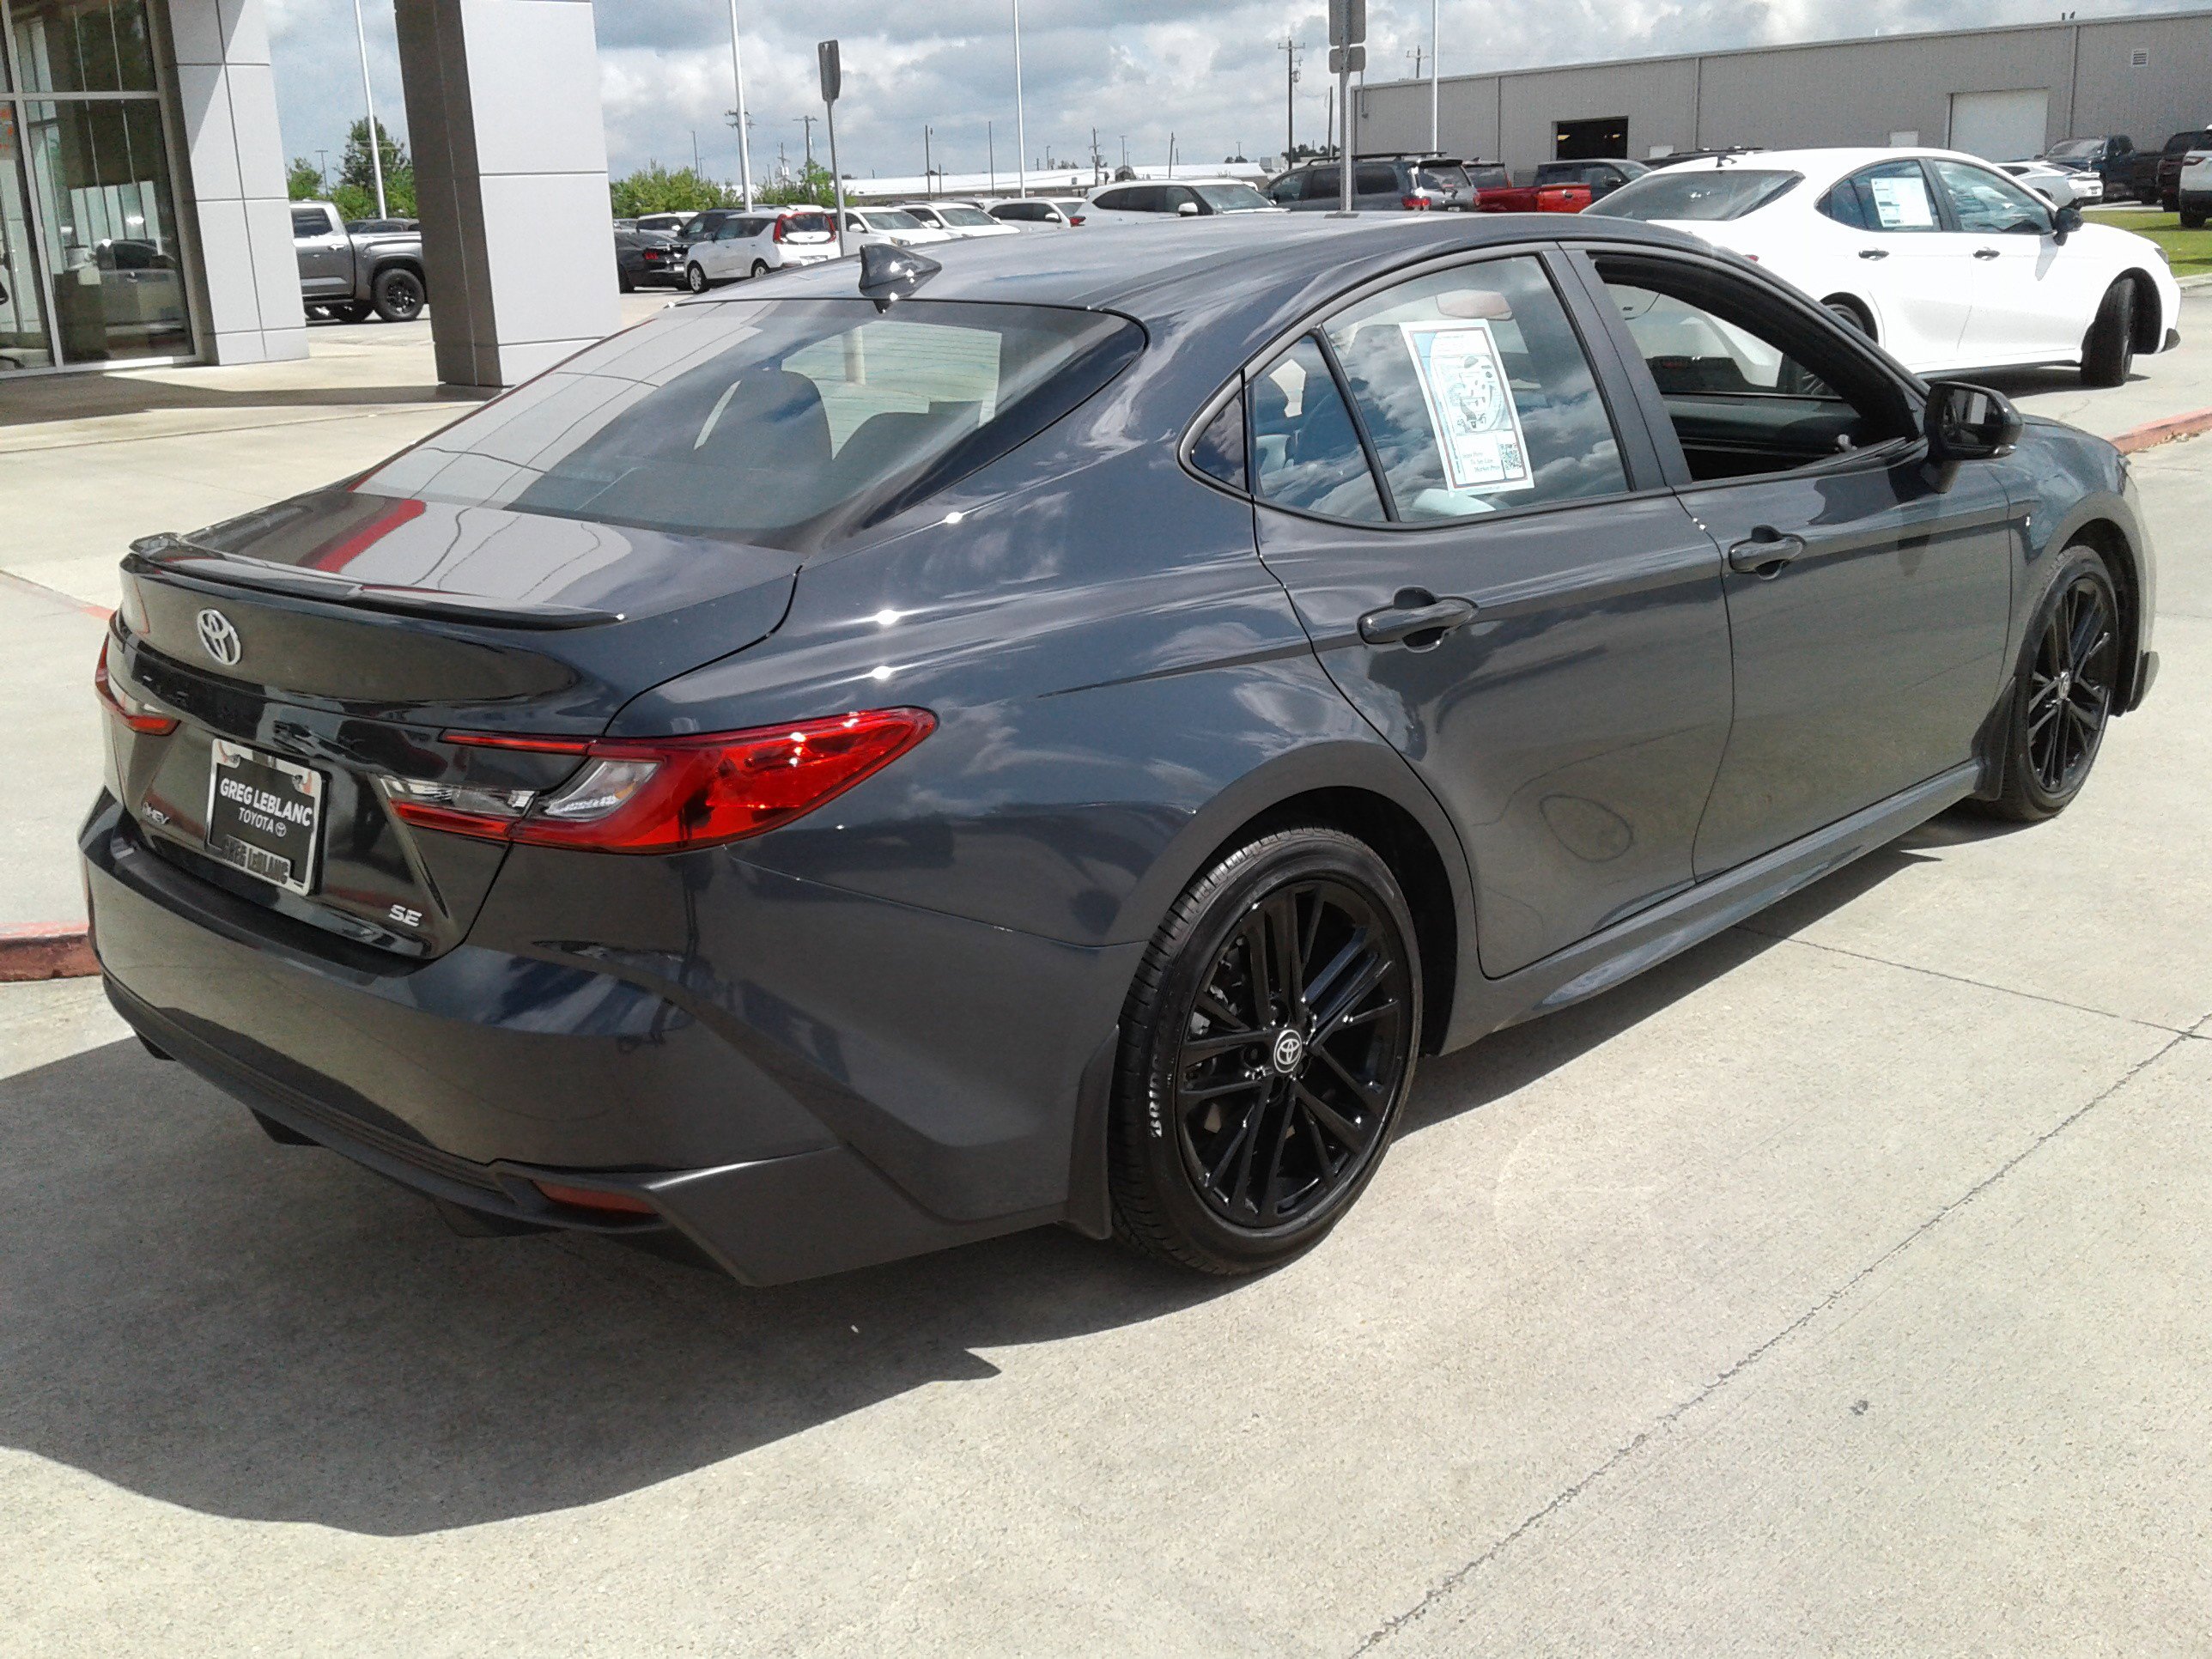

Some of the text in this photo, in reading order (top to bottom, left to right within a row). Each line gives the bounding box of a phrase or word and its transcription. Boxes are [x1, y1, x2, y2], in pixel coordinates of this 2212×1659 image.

[220, 777, 313, 826] GREG LEBLANC
[238, 807, 274, 834] TOYOTA
[389, 904, 422, 927] SE
